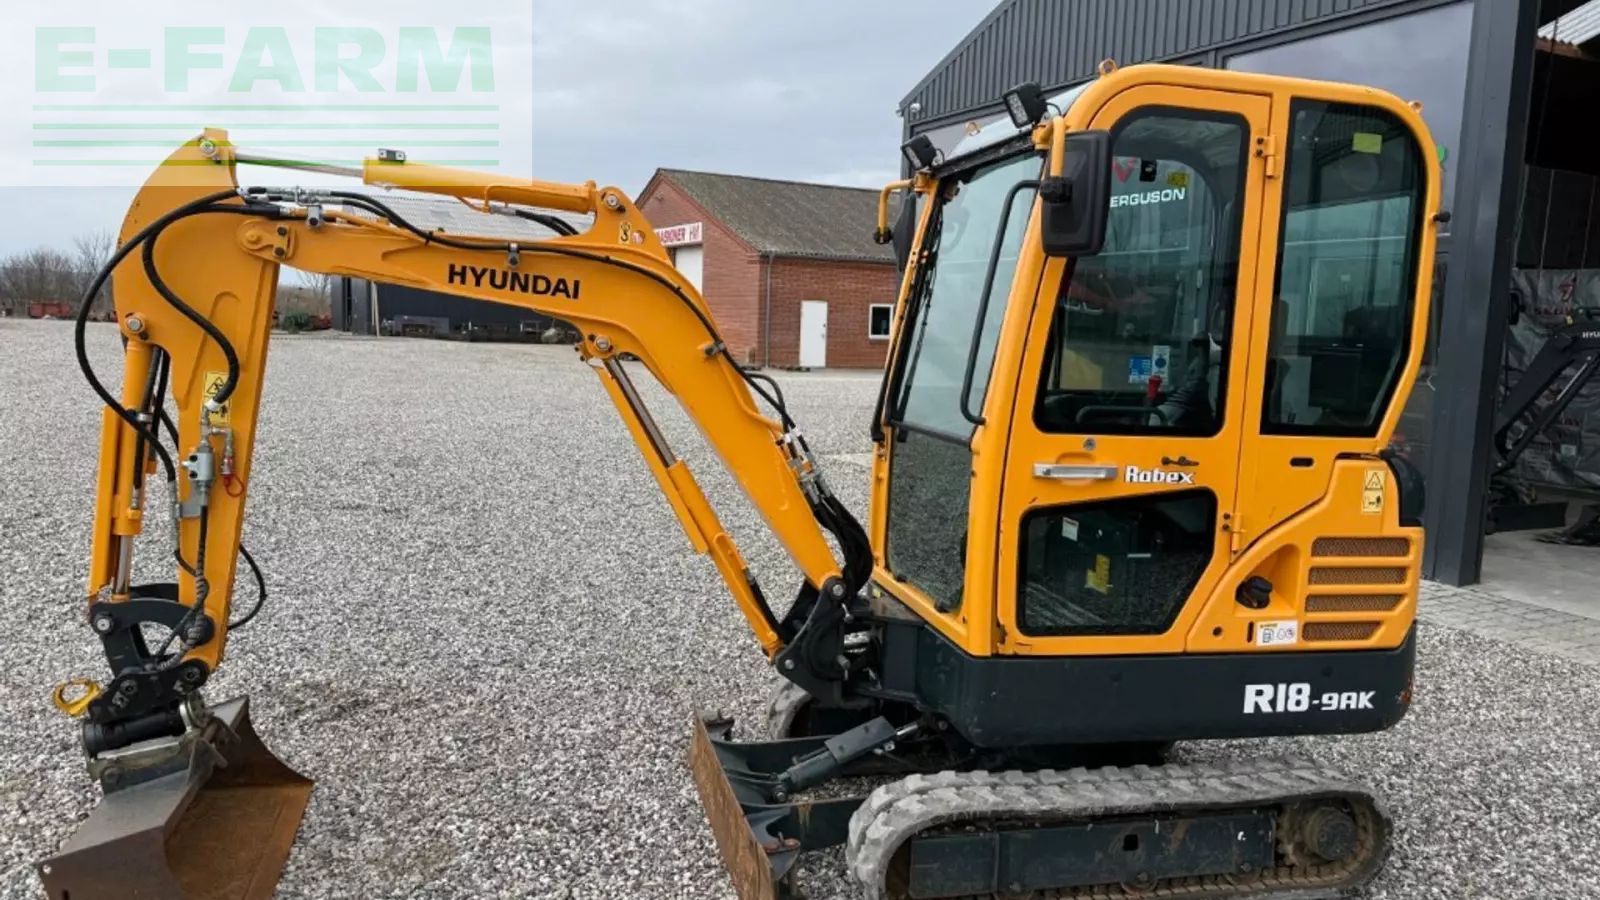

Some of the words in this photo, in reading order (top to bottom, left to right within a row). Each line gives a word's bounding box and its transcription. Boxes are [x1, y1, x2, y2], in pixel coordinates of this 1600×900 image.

[1110, 187, 1185, 208] ERGUSON
[448, 263, 580, 300] HYUNDAI
[1125, 465, 1194, 484] Robex
